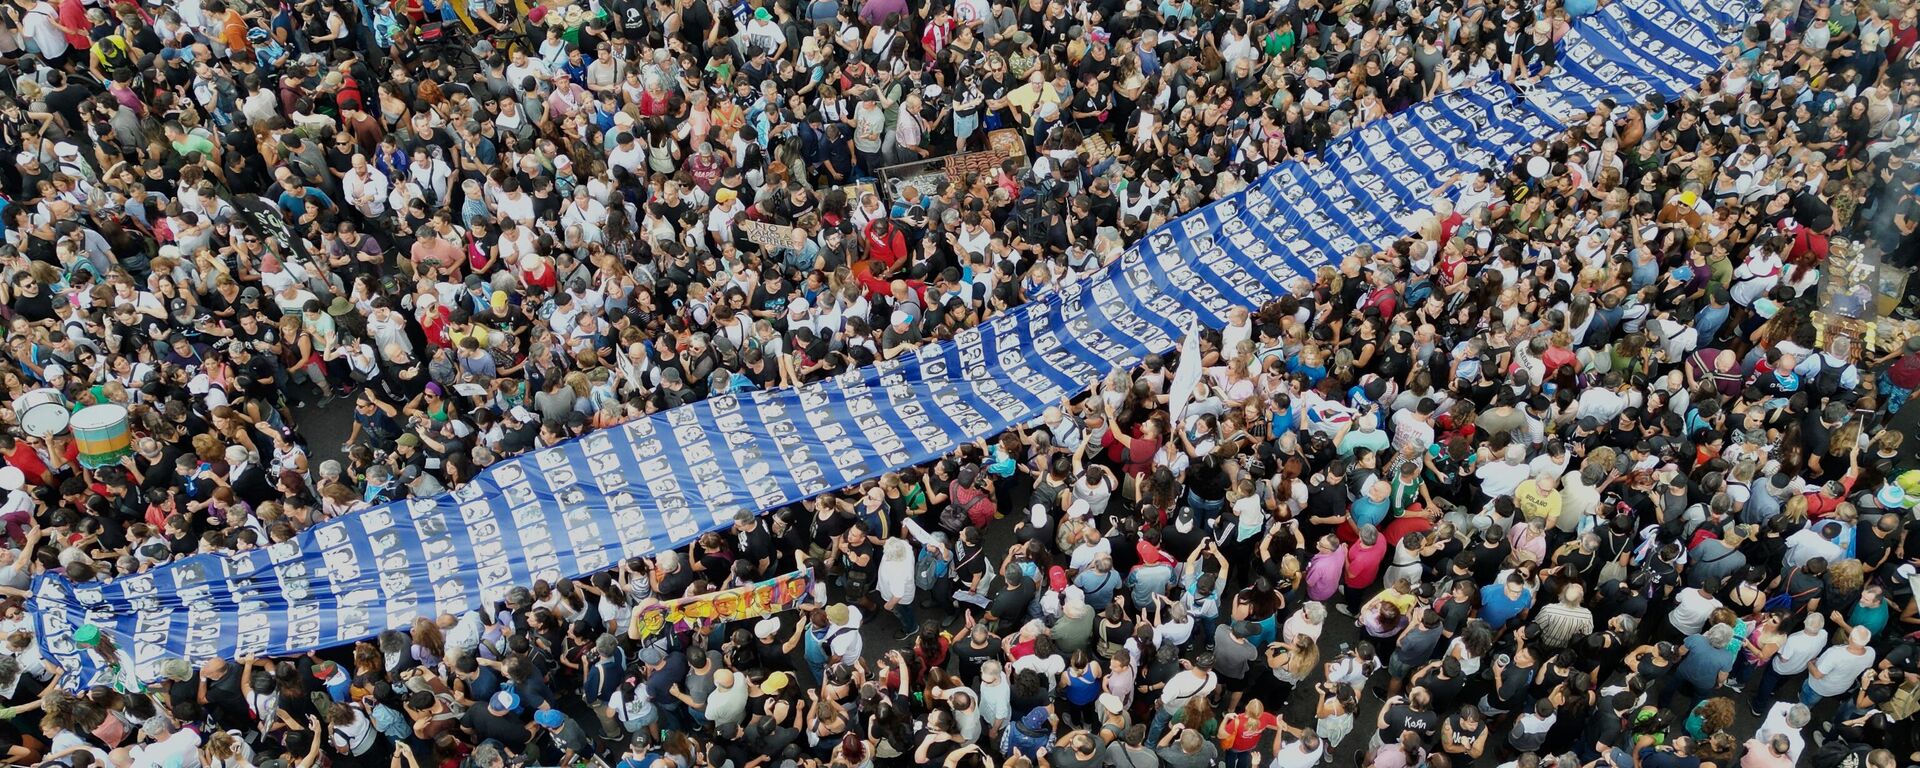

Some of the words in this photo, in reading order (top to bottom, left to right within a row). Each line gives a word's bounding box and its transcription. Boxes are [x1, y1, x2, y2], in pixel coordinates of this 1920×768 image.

[748, 227, 781, 239] VAMOS
[755, 222, 778, 232] NO
[750, 233, 794, 248] CORRER
[1519, 349, 1534, 371] PRENSA
